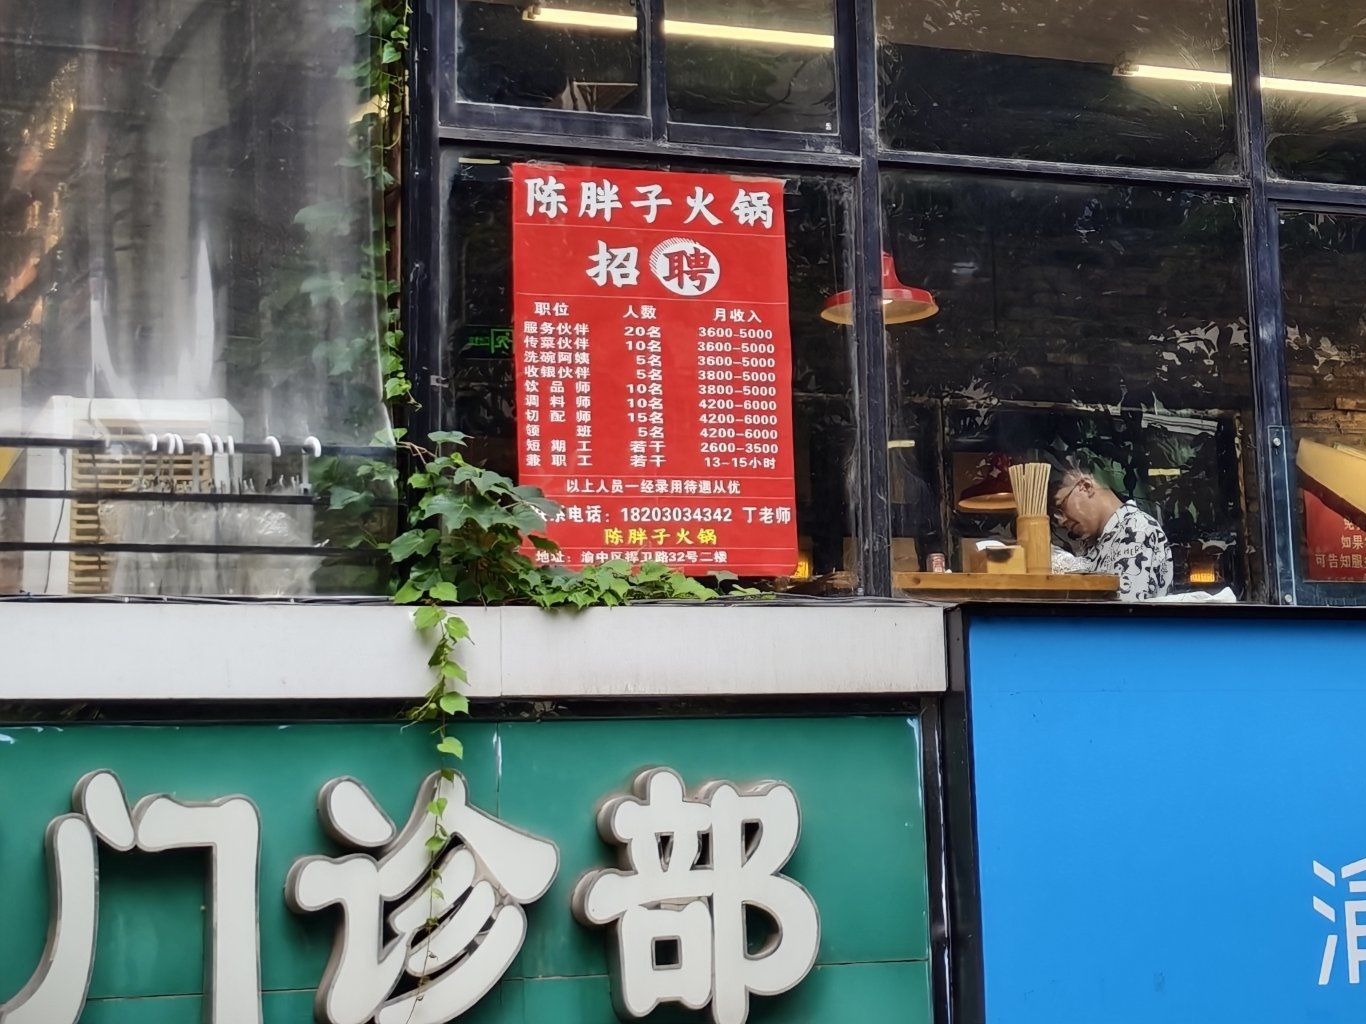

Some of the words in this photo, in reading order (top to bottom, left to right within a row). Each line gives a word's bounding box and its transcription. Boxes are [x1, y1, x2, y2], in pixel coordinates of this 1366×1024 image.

[523, 175, 774, 229] 陈胖子火锅
[585, 239, 717, 293] 招聘
[534, 301, 569, 316] 职位
[622, 305, 657, 319] 人数
[713, 307, 762, 323] 月收入
[523, 321, 589, 335] 服务伙伴
[624, 326, 661, 337] 20名
[698, 327, 773, 339] 3600-5000
[523, 336, 589, 350] 传菜伙伴
[625, 340, 661, 352] 10名
[697, 341, 775, 354] 3600-5000
[524, 351, 590, 364] 洗碗阿姨
[636, 354, 662, 366] 5名
[697, 356, 776, 368] 3600-5000
[524, 365, 590, 379] 收银伙伴
[636, 369, 663, 381] 5名
[698, 370, 776, 382] 3800-5000
[626, 383, 663, 395] 10名
[698, 384, 777, 396] 3800-5000
[627, 398, 663, 410] 10名
[699, 399, 777, 411] 4200-6000
[627, 412, 664, 424] 15名
[699, 413, 778, 425] 4200-6000
[638, 426, 664, 438] 5名
[700, 428, 778, 439] 4200-6000
[629, 440, 667, 453] 若干
[700, 442, 779, 454] 2600-3500
[629, 455, 667, 468] 若干
[704, 457, 776, 469] 13-15小时
[565, 478, 741, 494] 以上人员一经录用待遇从优
[620, 507, 733, 523] 18203034342
[742, 506, 792, 525] 丁老师
[604, 527, 717, 546] 陈胖子火锅
[0, 767, 822, 1024] 门诊部
